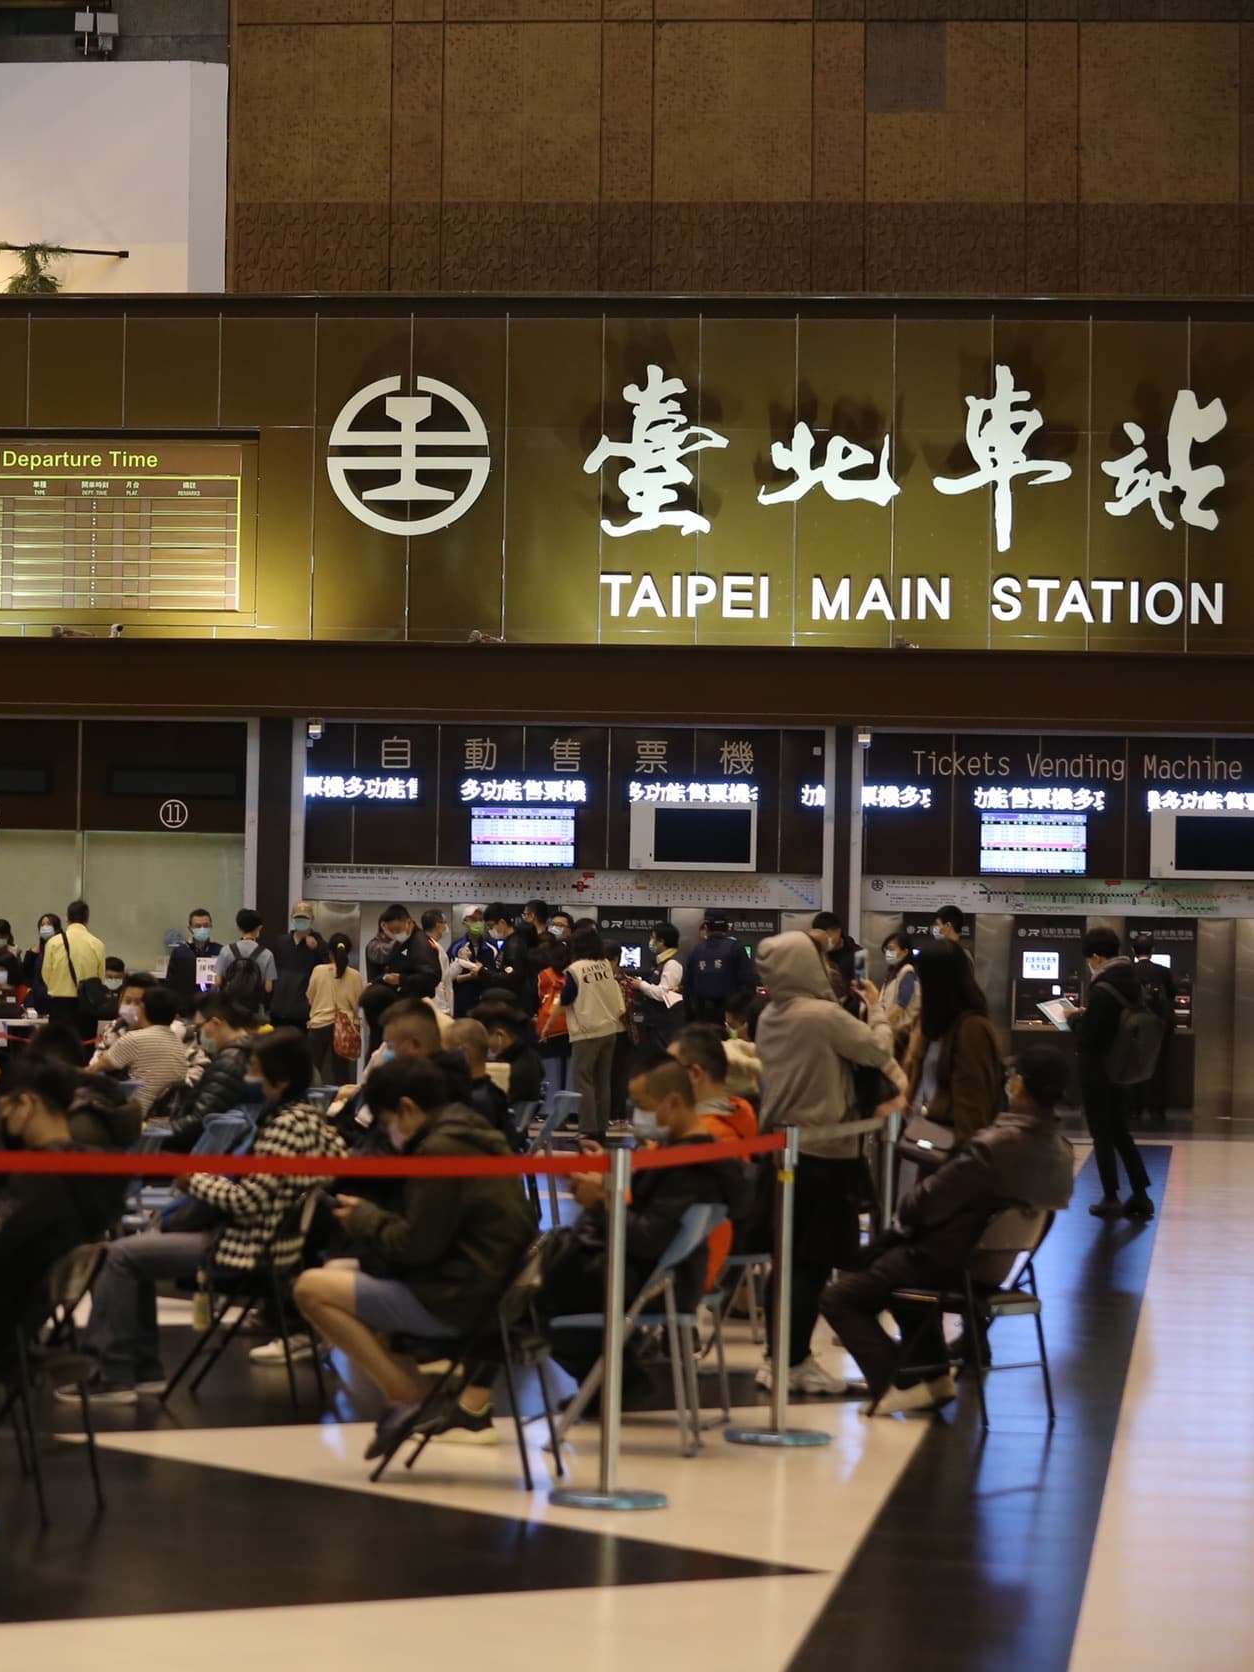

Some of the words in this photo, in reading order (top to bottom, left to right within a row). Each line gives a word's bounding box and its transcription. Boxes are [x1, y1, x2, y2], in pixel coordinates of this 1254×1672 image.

[3, 451, 102, 471] Departure
[109, 451, 158, 468] Time
[583, 364, 1228, 552] 臺北車站
[600, 574, 769, 619] TAIPEI
[812, 577, 950, 621] MAIN
[990, 578, 1223, 625] STATION
[381, 736, 754, 776] 自動售票機
[913, 750, 1011, 777] Tickets
[1026, 753, 1125, 781] Vending
[1143, 755, 1243, 780] Machine
